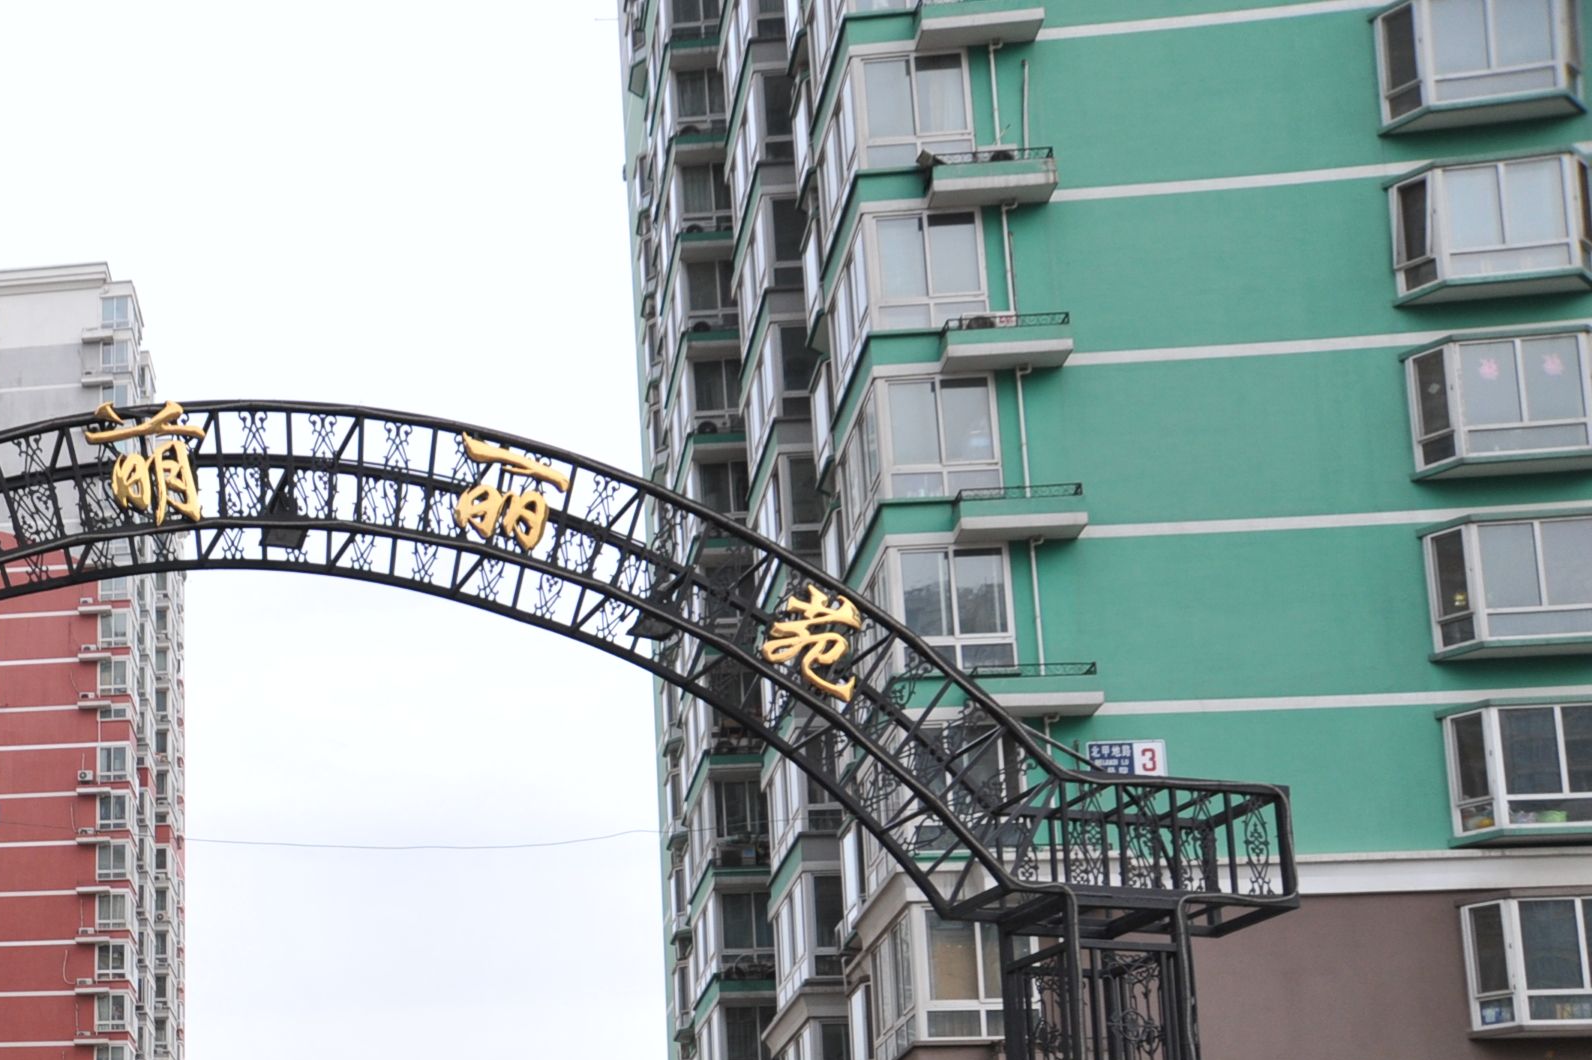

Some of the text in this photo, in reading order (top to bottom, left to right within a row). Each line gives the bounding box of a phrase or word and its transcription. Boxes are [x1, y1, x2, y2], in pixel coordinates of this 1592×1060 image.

[1090, 745, 1131, 758] 北甲地路
[1141, 748, 1157, 772] 3
